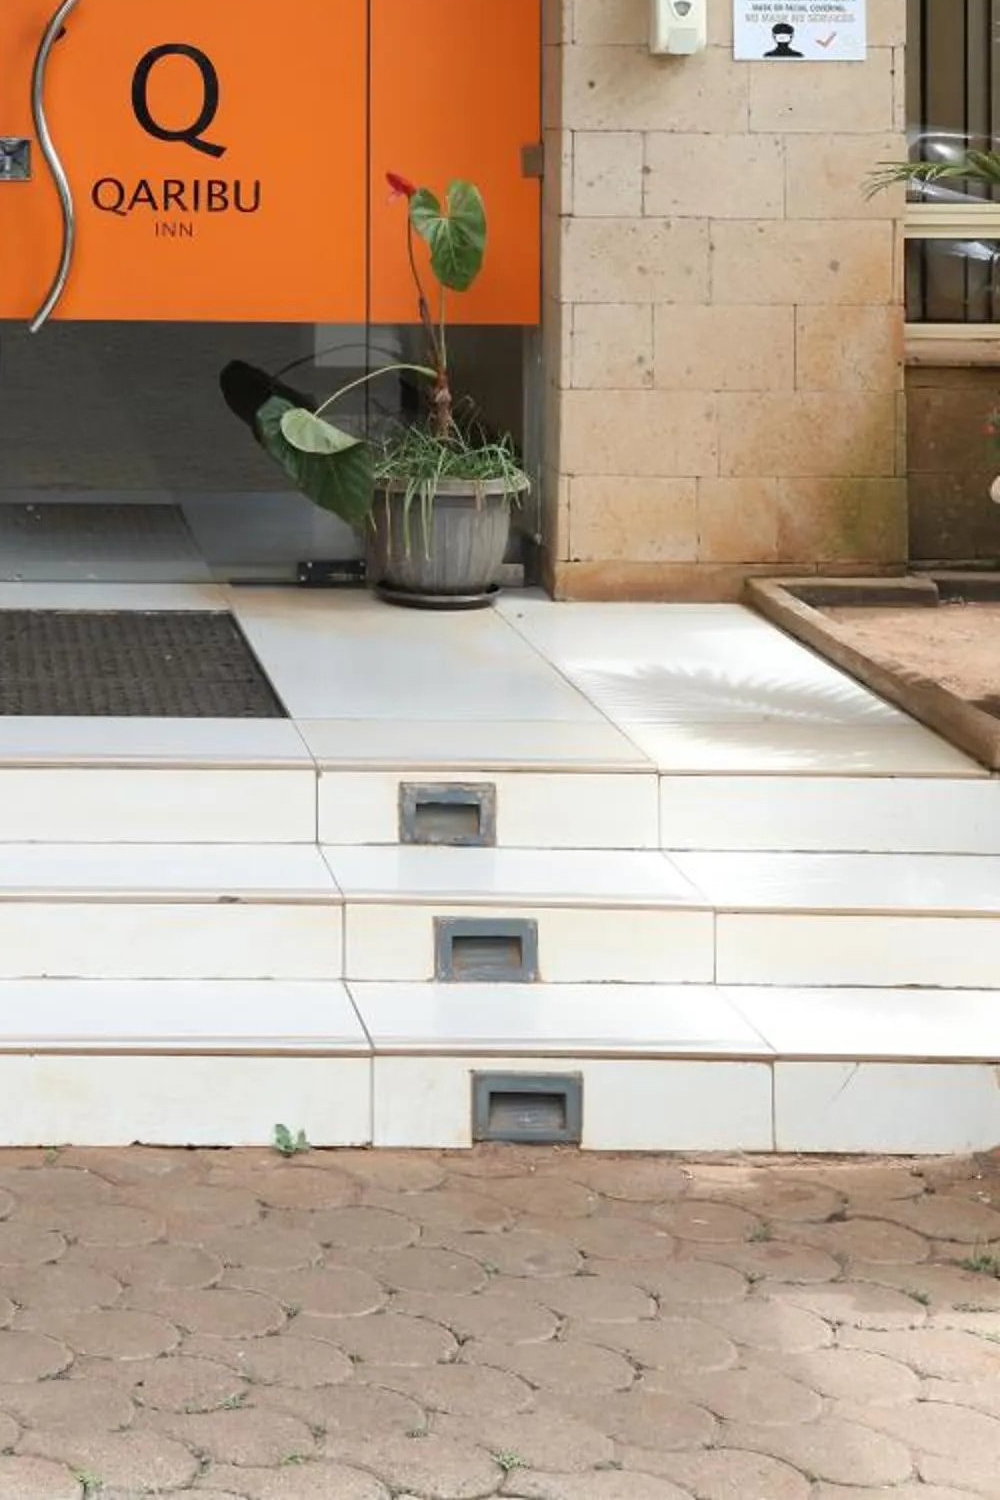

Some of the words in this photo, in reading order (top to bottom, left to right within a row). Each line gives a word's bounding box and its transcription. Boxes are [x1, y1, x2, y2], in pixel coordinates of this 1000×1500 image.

[132, 43, 228, 159] Q
[91, 177, 261, 216] QARIBU
[155, 221, 193, 237] INN
